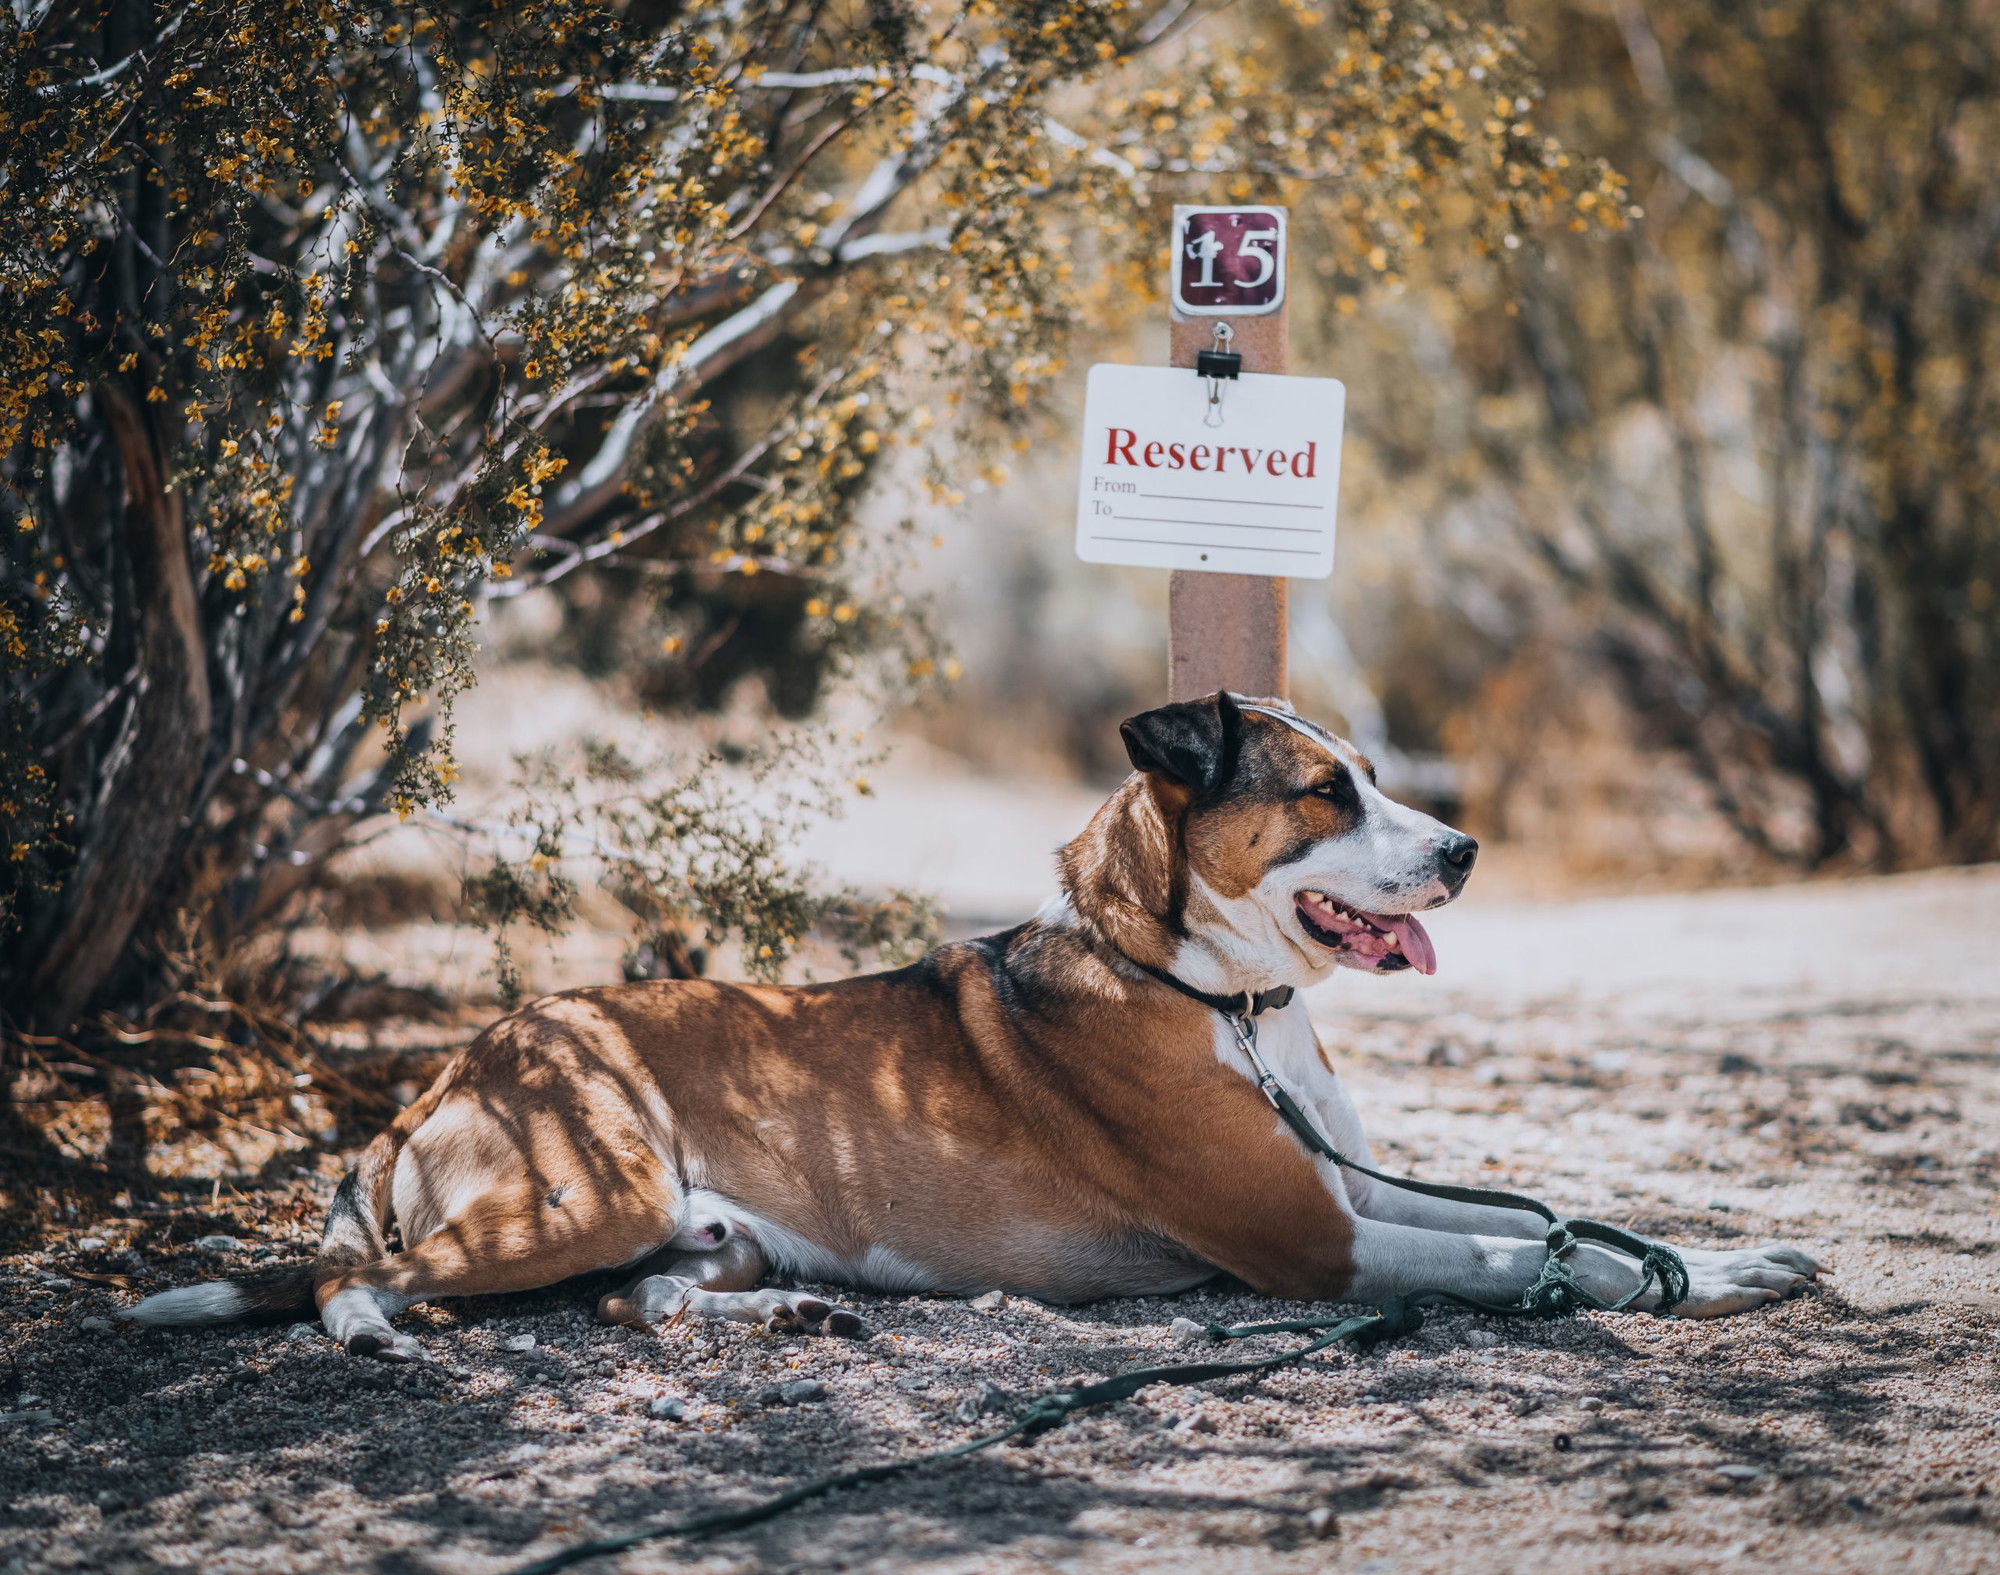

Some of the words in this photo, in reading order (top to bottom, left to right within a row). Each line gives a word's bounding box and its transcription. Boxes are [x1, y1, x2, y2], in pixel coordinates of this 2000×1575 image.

[1188, 229, 1277, 288] 15
[1103, 427, 1317, 478] Reserved
[1093, 476, 1137, 493] From
[1092, 500, 1112, 515] To
